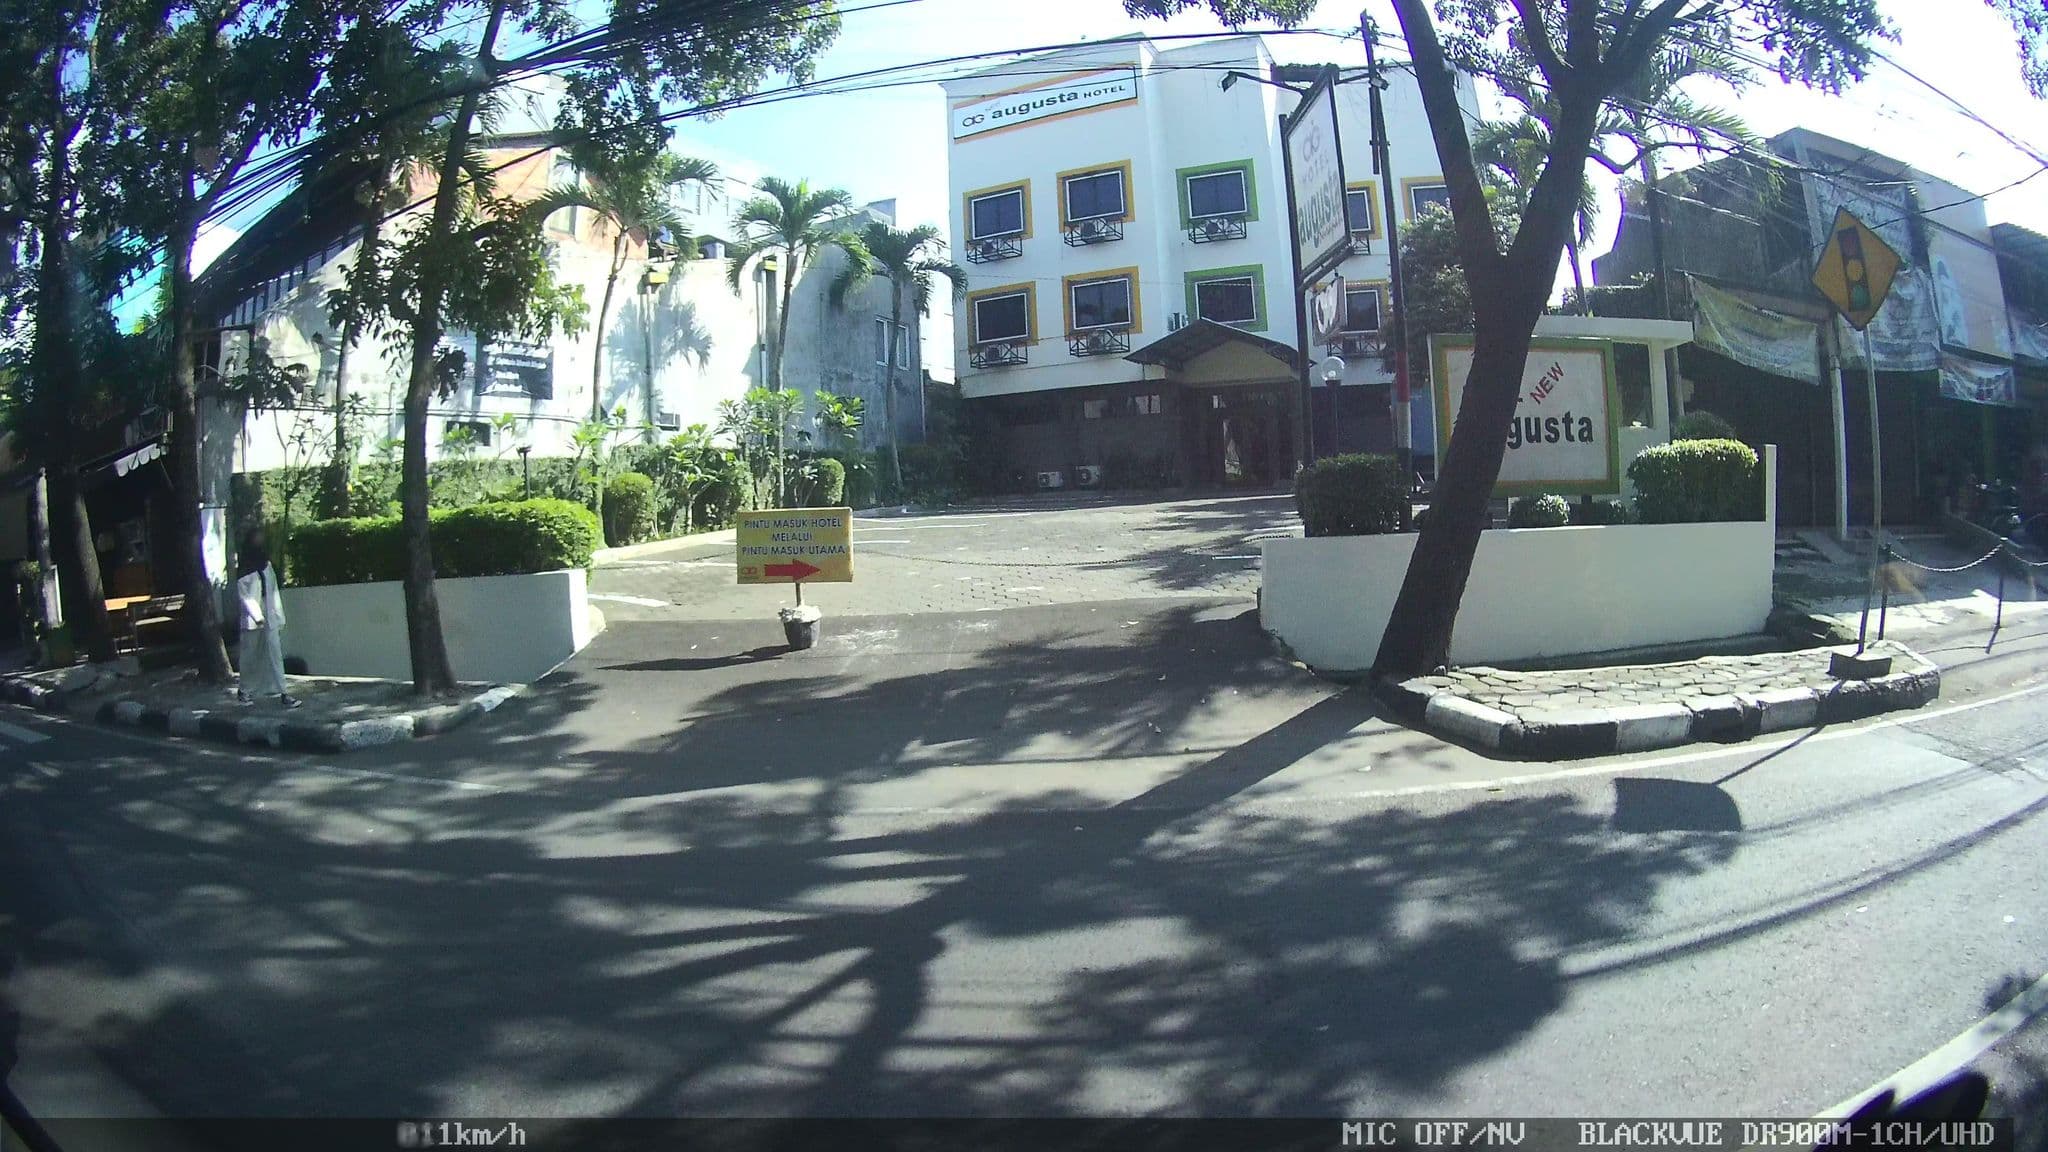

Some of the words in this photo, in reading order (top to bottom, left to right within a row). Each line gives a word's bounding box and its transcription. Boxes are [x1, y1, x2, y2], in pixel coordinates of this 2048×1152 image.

[991, 91, 1079, 119] augusta
[1083, 85, 1126, 98] HOTEL
[1298, 170, 1341, 248] augusta
[1530, 361, 1565, 404] NEW
[1507, 411, 1594, 449] gusta
[744, 519, 769, 529] PINTU
[773, 519, 809, 529] MASUK
[811, 518, 842, 528] HOTEL
[772, 533, 813, 541] MELALUI
[742, 546, 768, 555] PINTU
[771, 546, 806, 555] MASUK
[808, 545, 845, 555] UTAMA
